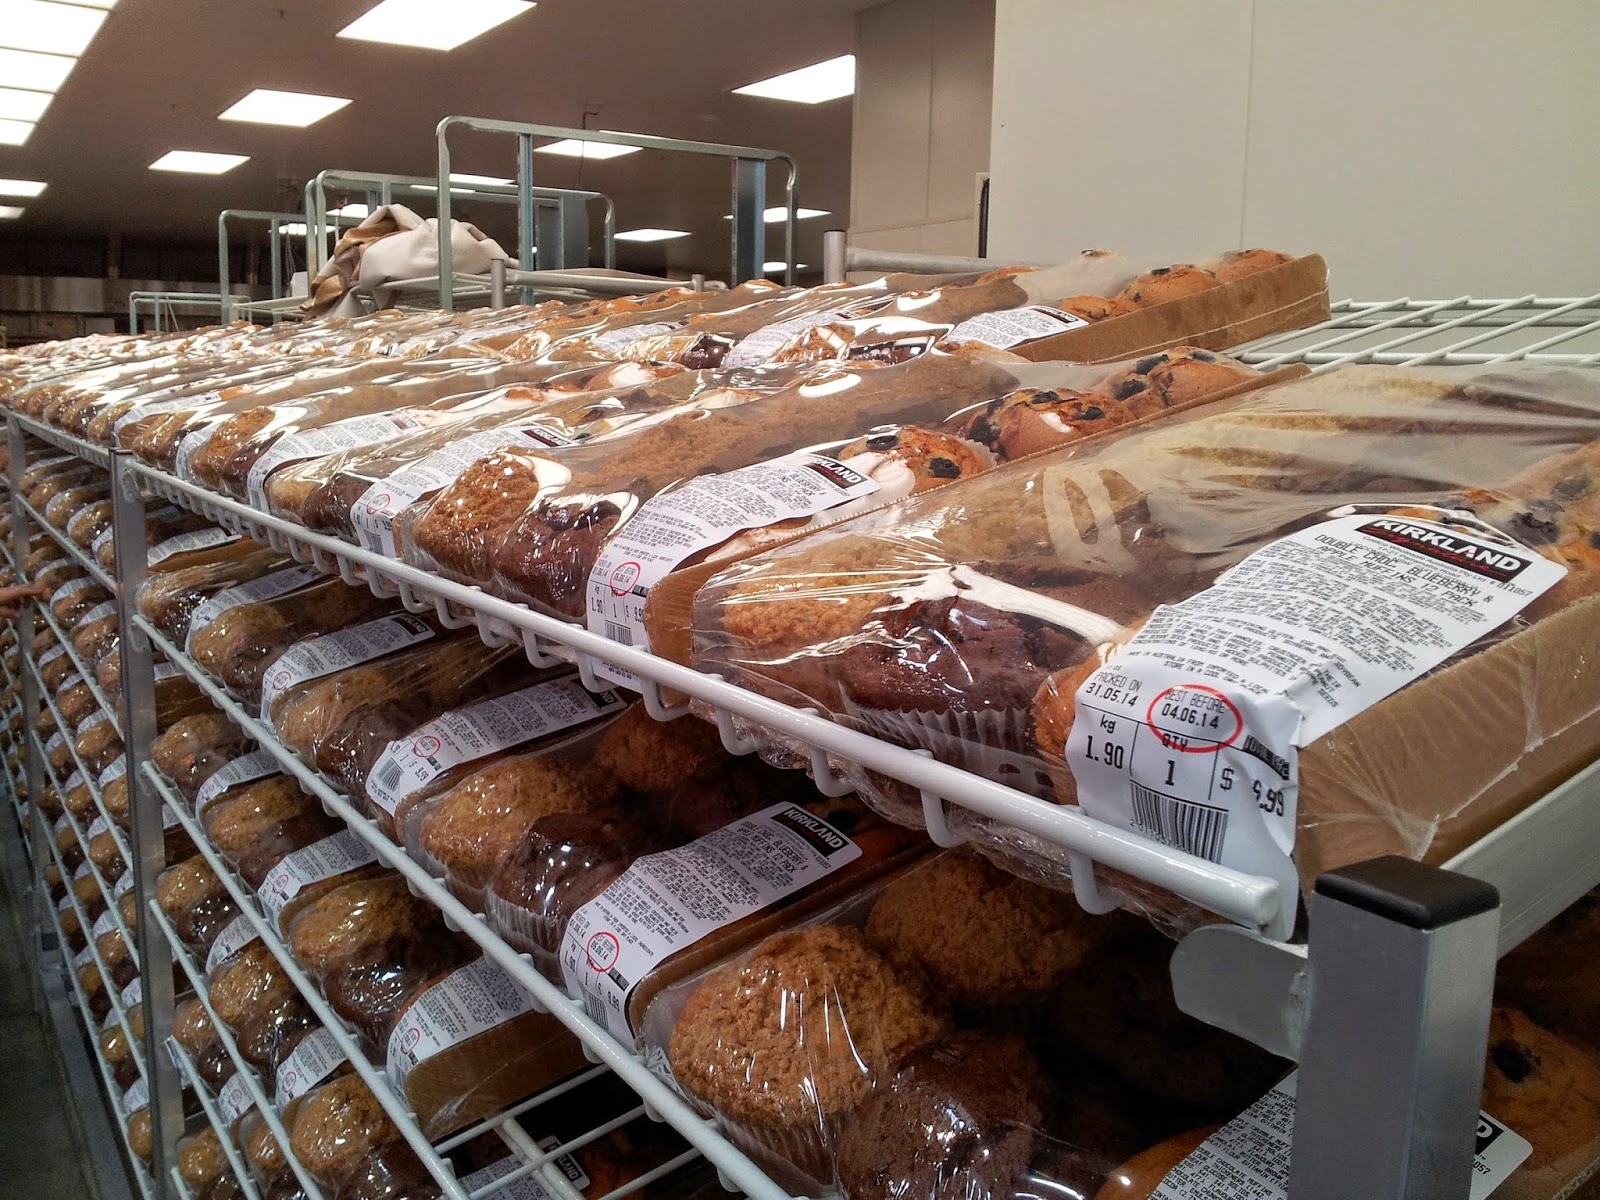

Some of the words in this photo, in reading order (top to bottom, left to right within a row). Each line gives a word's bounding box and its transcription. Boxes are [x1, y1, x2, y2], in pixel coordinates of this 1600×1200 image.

[1372, 519, 1522, 571] KIRKLAND
[1313, 534, 1361, 554] DOUBLE
[1406, 566, 1482, 597] BLUEBERRY
[1316, 545, 1359, 561] APPLE
[1359, 560, 1416, 583] MUFFINS
[1420, 582, 1439, 591] 12
[1440, 590, 1478, 607] PACK
[1427, 556, 1458, 572] Australia
[1093, 671, 1128, 688] PACKED
[1128, 679, 1143, 692] ON
[1163, 660, 1185, 670] STORE
[1203, 669, 1222, 679] COOL
[1085, 682, 1139, 707] 31.05.14
[1189, 692, 1226, 714] BEFORE
[1099, 713, 1117, 734] kg
[1161, 702, 1221, 729] 04.06.14
[1085, 735, 1124, 769] 1.90
[1162, 733, 1188, 752] QTY
[1164, 760, 1175, 786] 1
[1219, 766, 1235, 792] $
[783, 807, 844, 849] KIRKLAND
[773, 839, 805, 865] BLUEBERRY
[780, 860, 798, 874] PACK
[1212, 1162, 1245, 1186] THICKENERS
[1216, 1157, 1247, 1179] CHOCOLATE
[1472, 1160, 1491, 1175] 057
